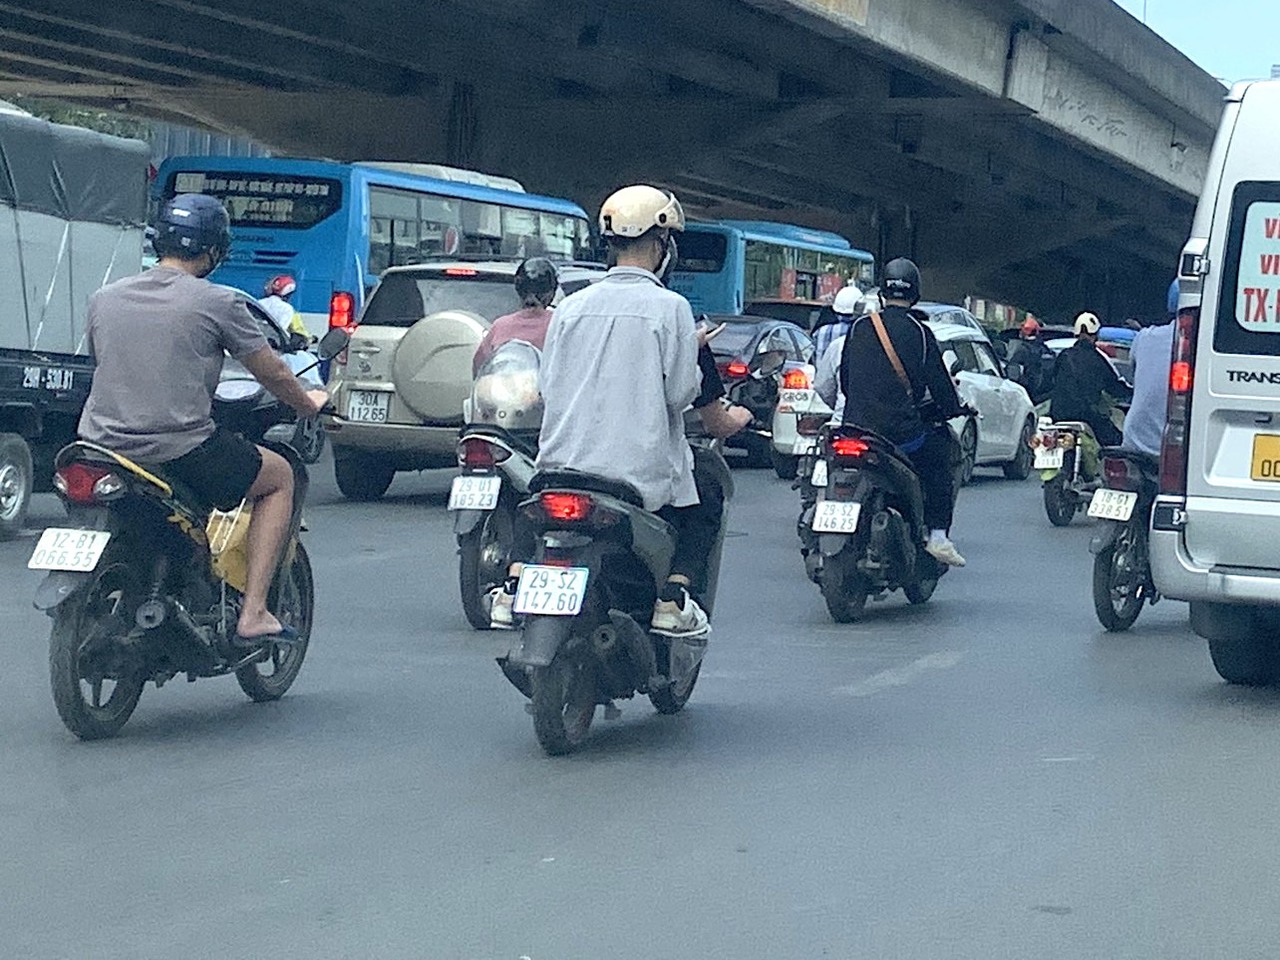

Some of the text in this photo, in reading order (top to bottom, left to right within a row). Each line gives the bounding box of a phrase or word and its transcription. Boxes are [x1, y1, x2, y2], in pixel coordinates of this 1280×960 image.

[358, 392, 379, 407] 30A
[51, 532, 98, 550] 12-B1
[34, 549, 96, 568] 066.55
[528, 570, 578, 591] 29-S2
[522, 591, 578, 612] 147.60
